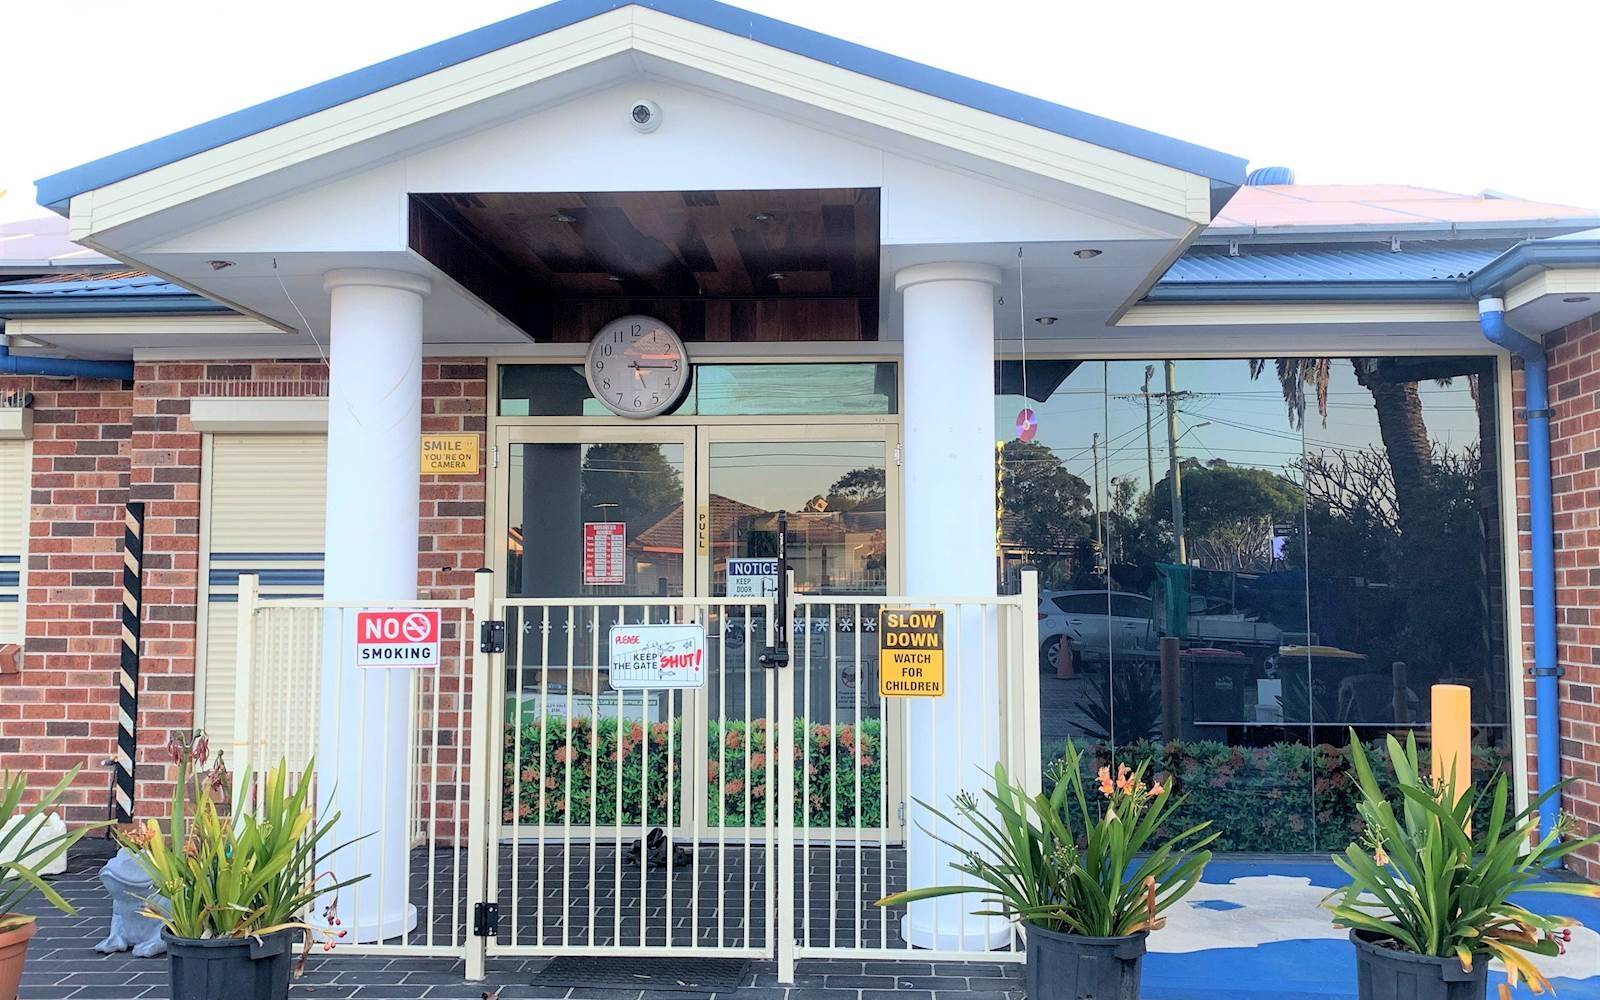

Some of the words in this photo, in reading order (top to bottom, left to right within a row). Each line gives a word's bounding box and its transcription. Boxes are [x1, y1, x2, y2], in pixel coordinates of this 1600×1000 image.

[631, 324, 641, 337] 12
[614, 331, 624, 343] 11
[600, 344, 612, 356] 10
[664, 343, 671, 355] 2
[596, 361, 604, 373] 9
[671, 360, 679, 372] 3
[603, 377, 611, 389] 8
[664, 377, 671, 389] 4
[616, 393, 624, 404] 7
[633, 396, 642, 408] 6
[652, 392, 659, 404] 5
[423, 441, 462, 451] SMILE
[424, 453, 457, 461] YOU'RE
[458, 453, 472, 461] ON
[734, 563, 779, 575] NOTICE
[736, 577, 752, 585] KEEP
[887, 614, 937, 628] SLOW
[365, 618, 400, 640] NO
[615, 635, 640, 645] PLEASE
[886, 632, 939, 647] DOWN
[362, 647, 431, 659] SMOKING
[633, 653, 658, 661] KEEP
[894, 653, 931, 664] WATCH
[613, 662, 631, 670] THE
[633, 661, 658, 670] GATE
[659, 649, 702, 672] SHUT!
[902, 667, 923, 677] FOR
[885, 681, 939, 691] CHILDREN
